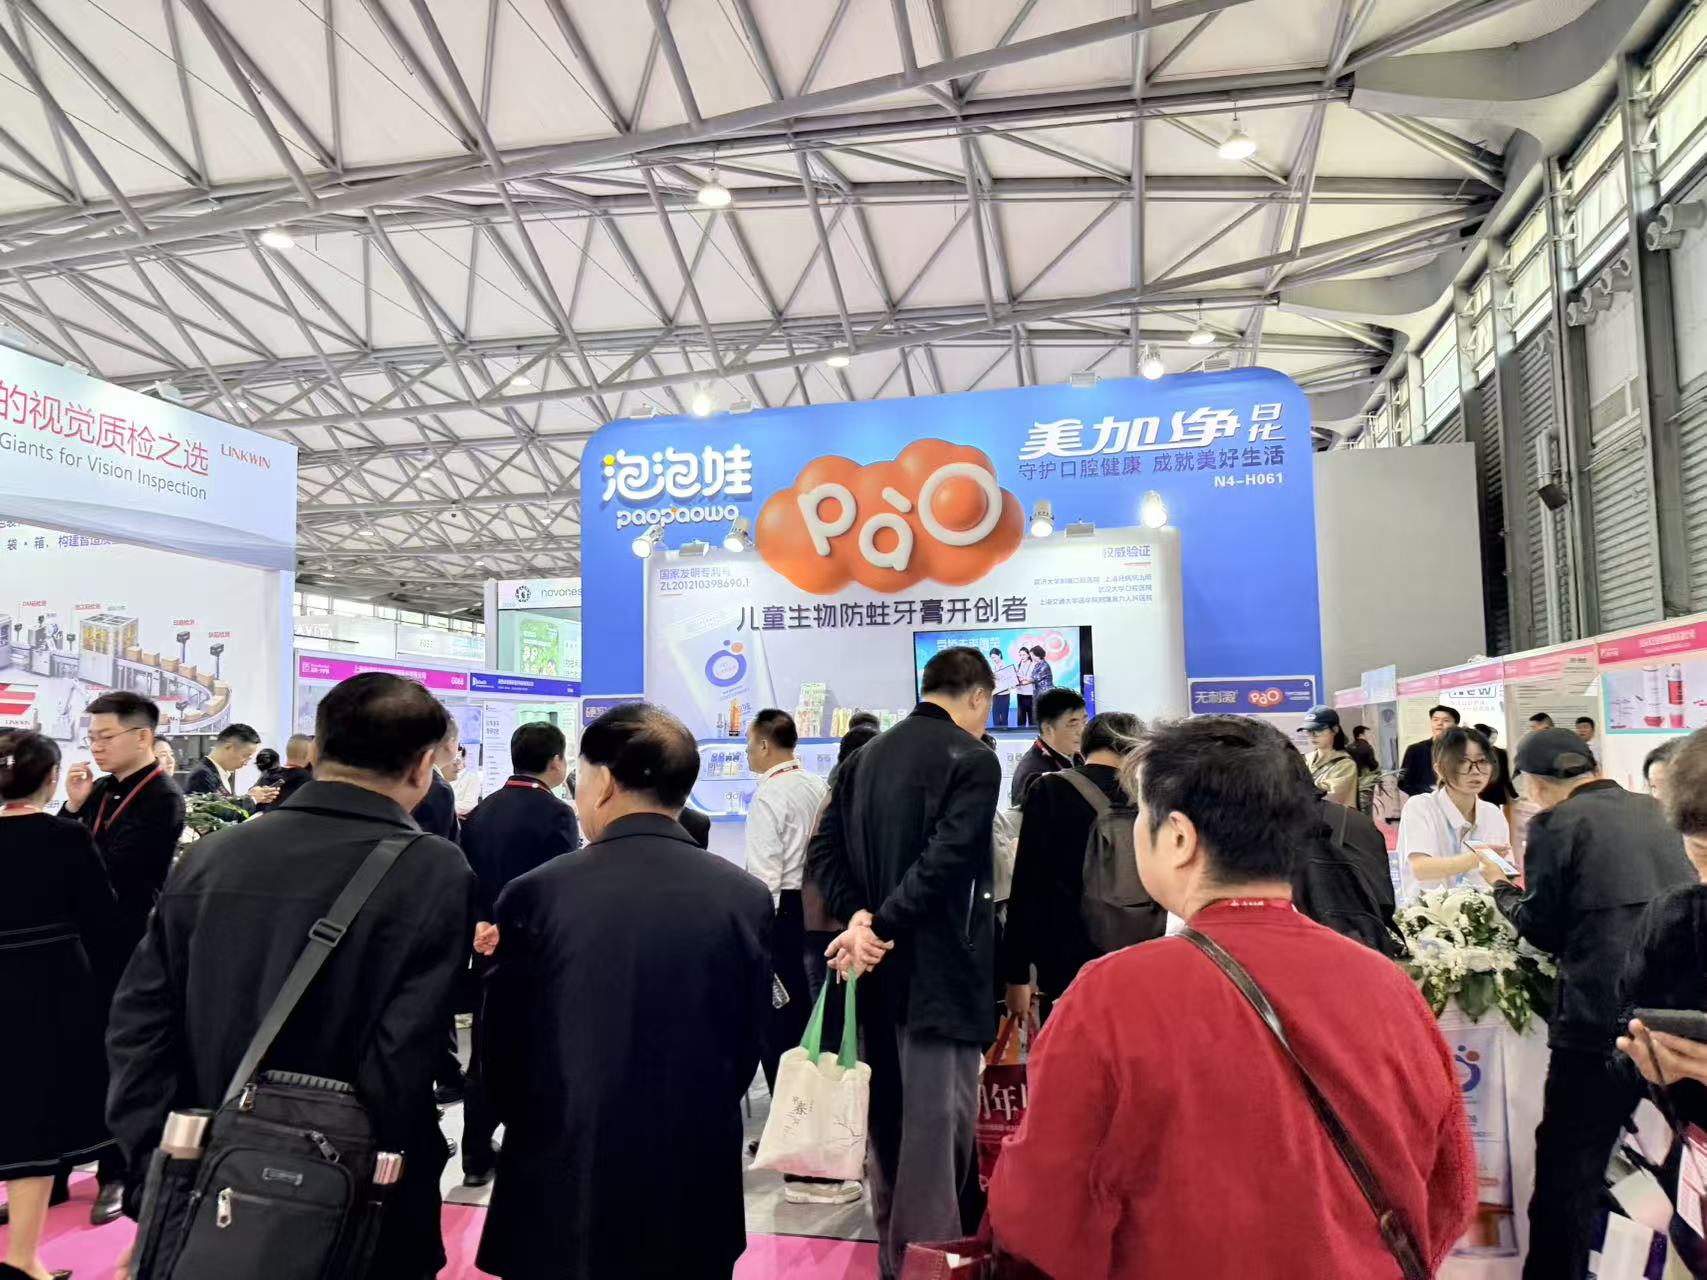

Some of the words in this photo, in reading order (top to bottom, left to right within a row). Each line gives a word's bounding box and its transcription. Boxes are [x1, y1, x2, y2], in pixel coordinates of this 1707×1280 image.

[0, 380, 209, 476] 的视觉质检之选
[0, 432, 54, 461] Giants
[60, 447, 83, 467] for
[88, 455, 133, 481] Vision
[138, 469, 207, 500] Inspection
[220, 443, 271, 469] LINKWIN
[602, 443, 752, 501] 泡泡娃
[1019, 456, 1142, 481] 守护口腔健康
[1152, 445, 1286, 473] 成就美好生活
[1214, 472, 1284, 488] N4-H061
[616, 504, 739, 529] paopaowa
[736, 595, 1028, 632] 儿童生物防蛀牙膏开创者
